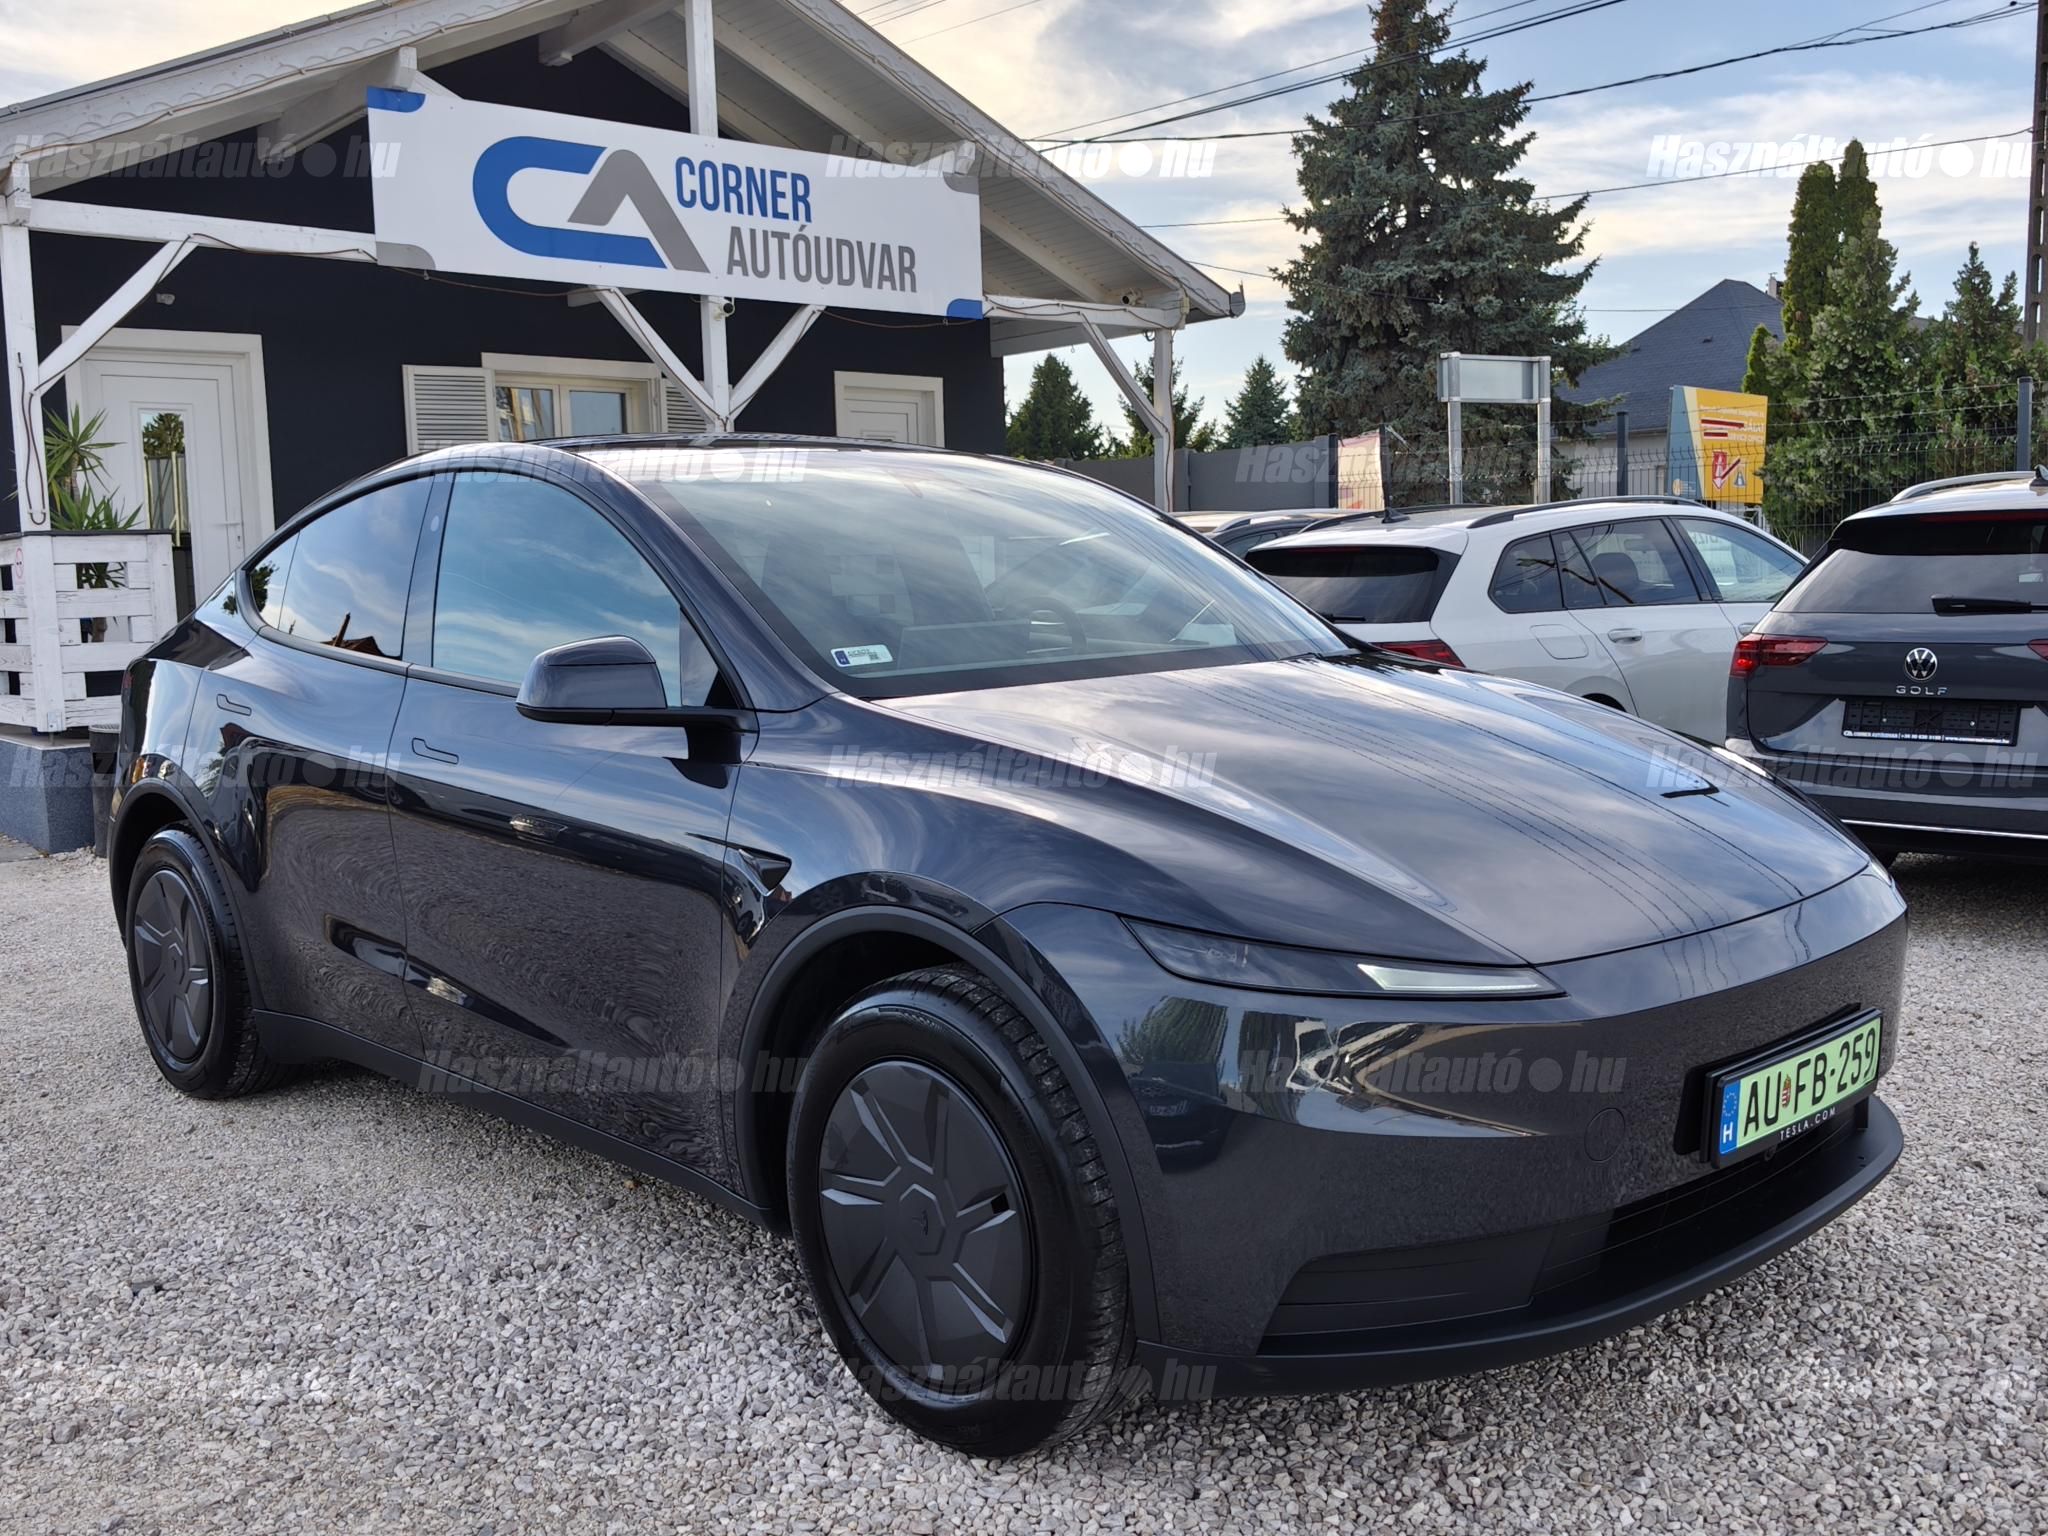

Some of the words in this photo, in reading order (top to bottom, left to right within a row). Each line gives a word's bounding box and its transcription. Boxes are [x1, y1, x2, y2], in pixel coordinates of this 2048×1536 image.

[473, 136, 710, 273] CA
[675, 156, 812, 223] CORNER
[727, 225, 917, 293] AUTÓUDVAR
[1896, 685, 1948, 695] GOLF
[1723, 1121, 1734, 1144] H
[1780, 1107, 1836, 1141] TESLA.COM
